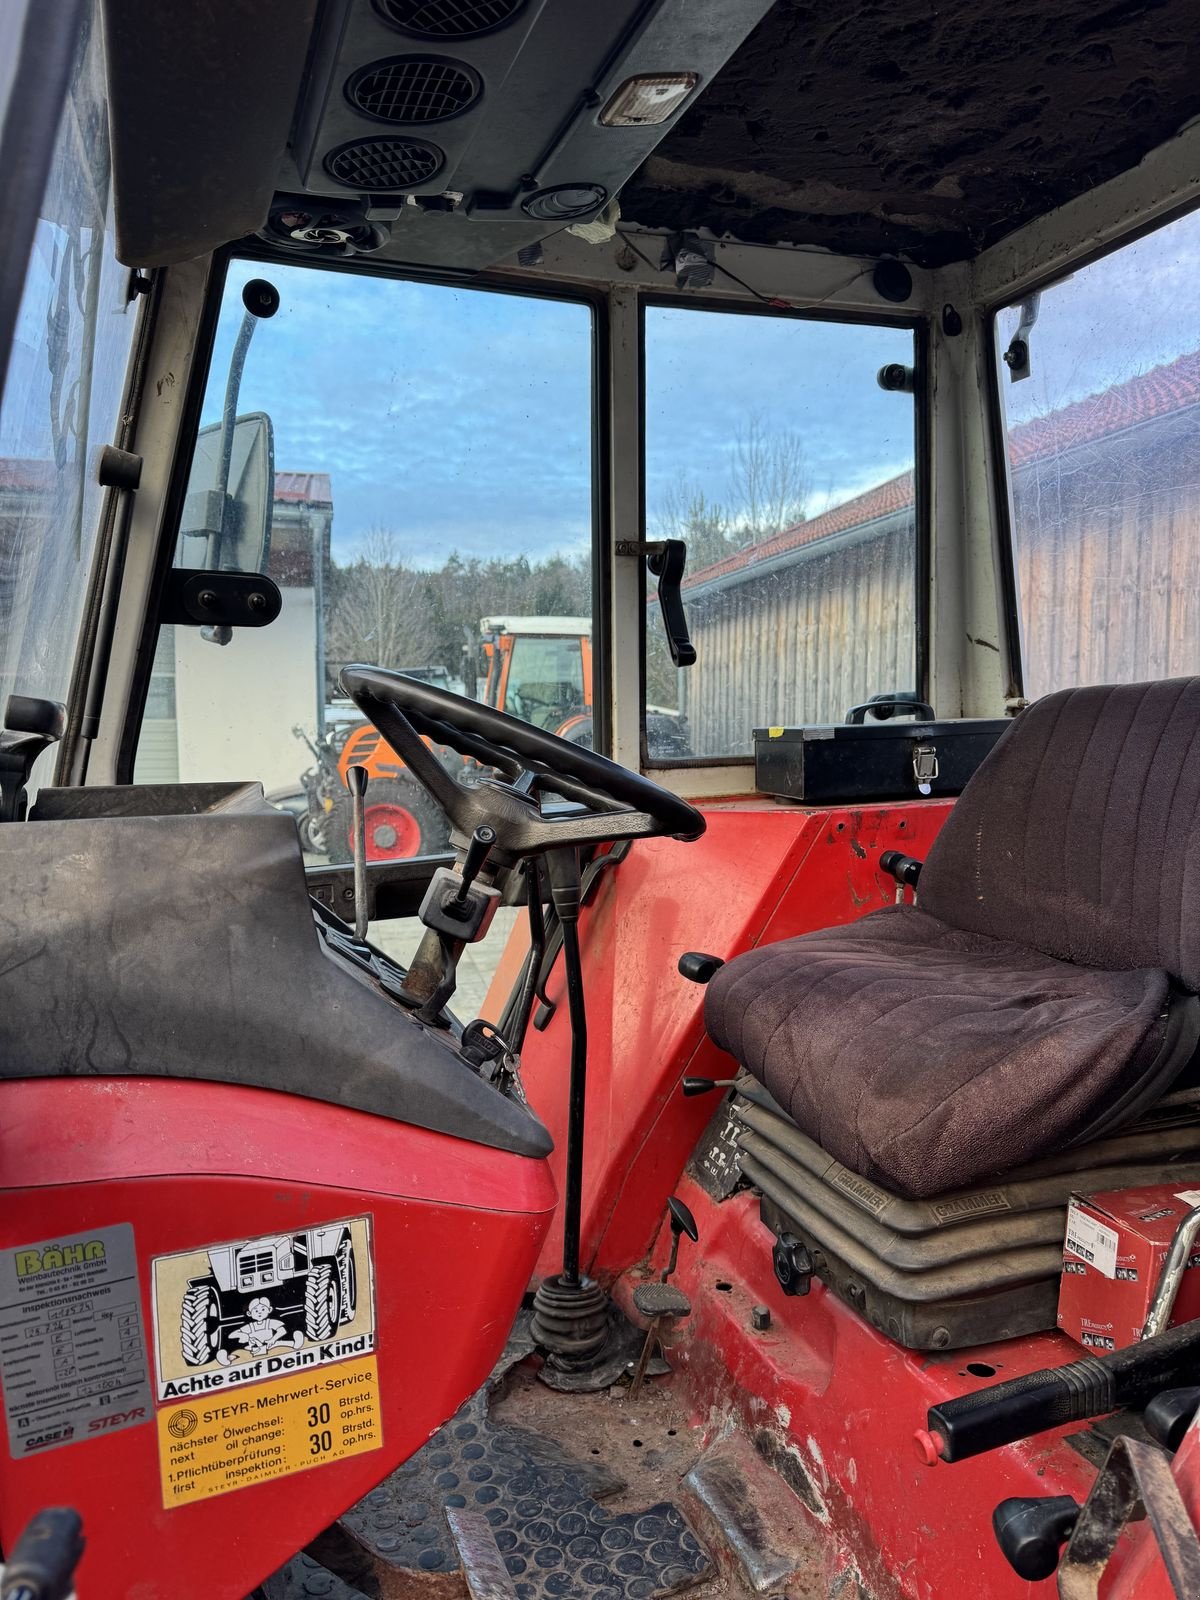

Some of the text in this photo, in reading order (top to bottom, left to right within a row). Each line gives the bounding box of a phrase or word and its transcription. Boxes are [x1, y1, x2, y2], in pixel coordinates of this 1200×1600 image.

[837, 1173, 885, 1209] GRAMMER
[935, 1193, 1004, 1217] GRAMMER
[15, 1240, 106, 1277] BÄHR
[18, 1265, 82, 1284] Weinbautechnik
[83, 1259, 107, 1270] GmbH
[22, 1287, 111, 1313] Inspektionsnachweis
[163, 1371, 223, 1398] Achte
[228, 1361, 263, 1383] auf
[267, 1352, 315, 1374] Dein
[339, 1392, 373, 1408] Btrstd.
[87, 1407, 145, 1432] STEYR
[307, 1402, 331, 1427] 30
[340, 1405, 374, 1421] op.hrs.
[26, 1430, 62, 1447] CASE
[169, 1416, 284, 1453] nächster Ölwechsel:
[342, 1419, 375, 1434] Btrstd.
[170, 1428, 285, 1466] next oil change:
[309, 1430, 332, 1455] 30
[342, 1432, 376, 1448] op.hrs.
[332, 1449, 345, 1457] AG
[173, 1481, 195, 1495] first
